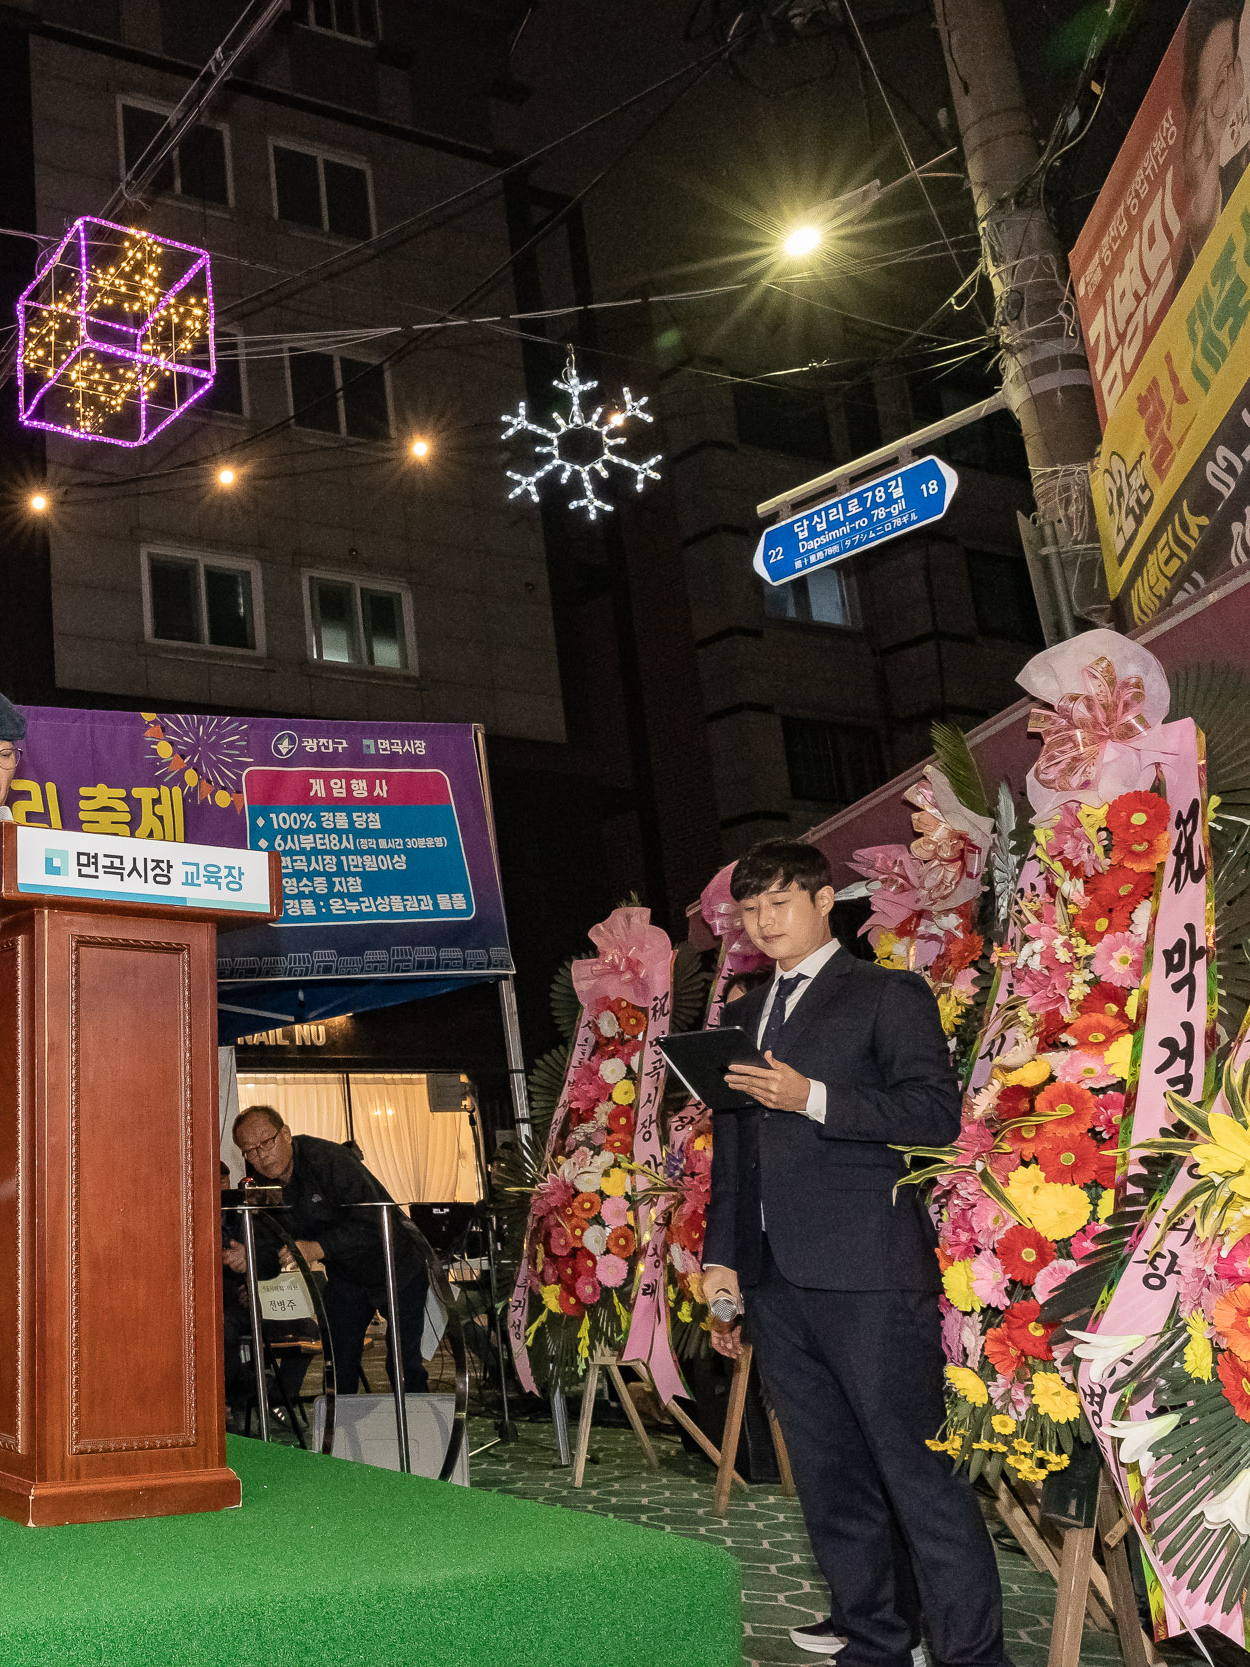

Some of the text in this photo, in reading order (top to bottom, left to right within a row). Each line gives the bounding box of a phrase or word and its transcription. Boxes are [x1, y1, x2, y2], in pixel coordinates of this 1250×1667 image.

[1101, 105, 1178, 266] 광진갑 당협위원장
[1088, 165, 1181, 418] 김병민
[920, 479, 939, 498] 18
[793, 476, 905, 540] 답십리로78길
[799, 498, 906, 553] Dapsimni-ro 78-gil
[768, 546, 784, 564] 22
[301, 738, 349, 753] 광진구
[377, 739, 426, 755] 면곡시장
[78, 783, 185, 842] 축제
[269, 812, 381, 829] 100% 경품 당첨
[274, 833, 354, 851] 6시부터8시
[356, 837, 376, 850] (정각
[1167, 798, 1207, 894] 祝
[76, 851, 245, 893] 면곡시장 교육장
[281, 854, 407, 872] 면곡시장 1만원이상
[282, 876, 363, 894] 영수증 지참
[285, 899, 317, 916] 경품
[329, 895, 433, 914] 온누리상품권과
[650, 991, 670, 1022] 祝
[270, 1299, 297, 1312] 전병주
